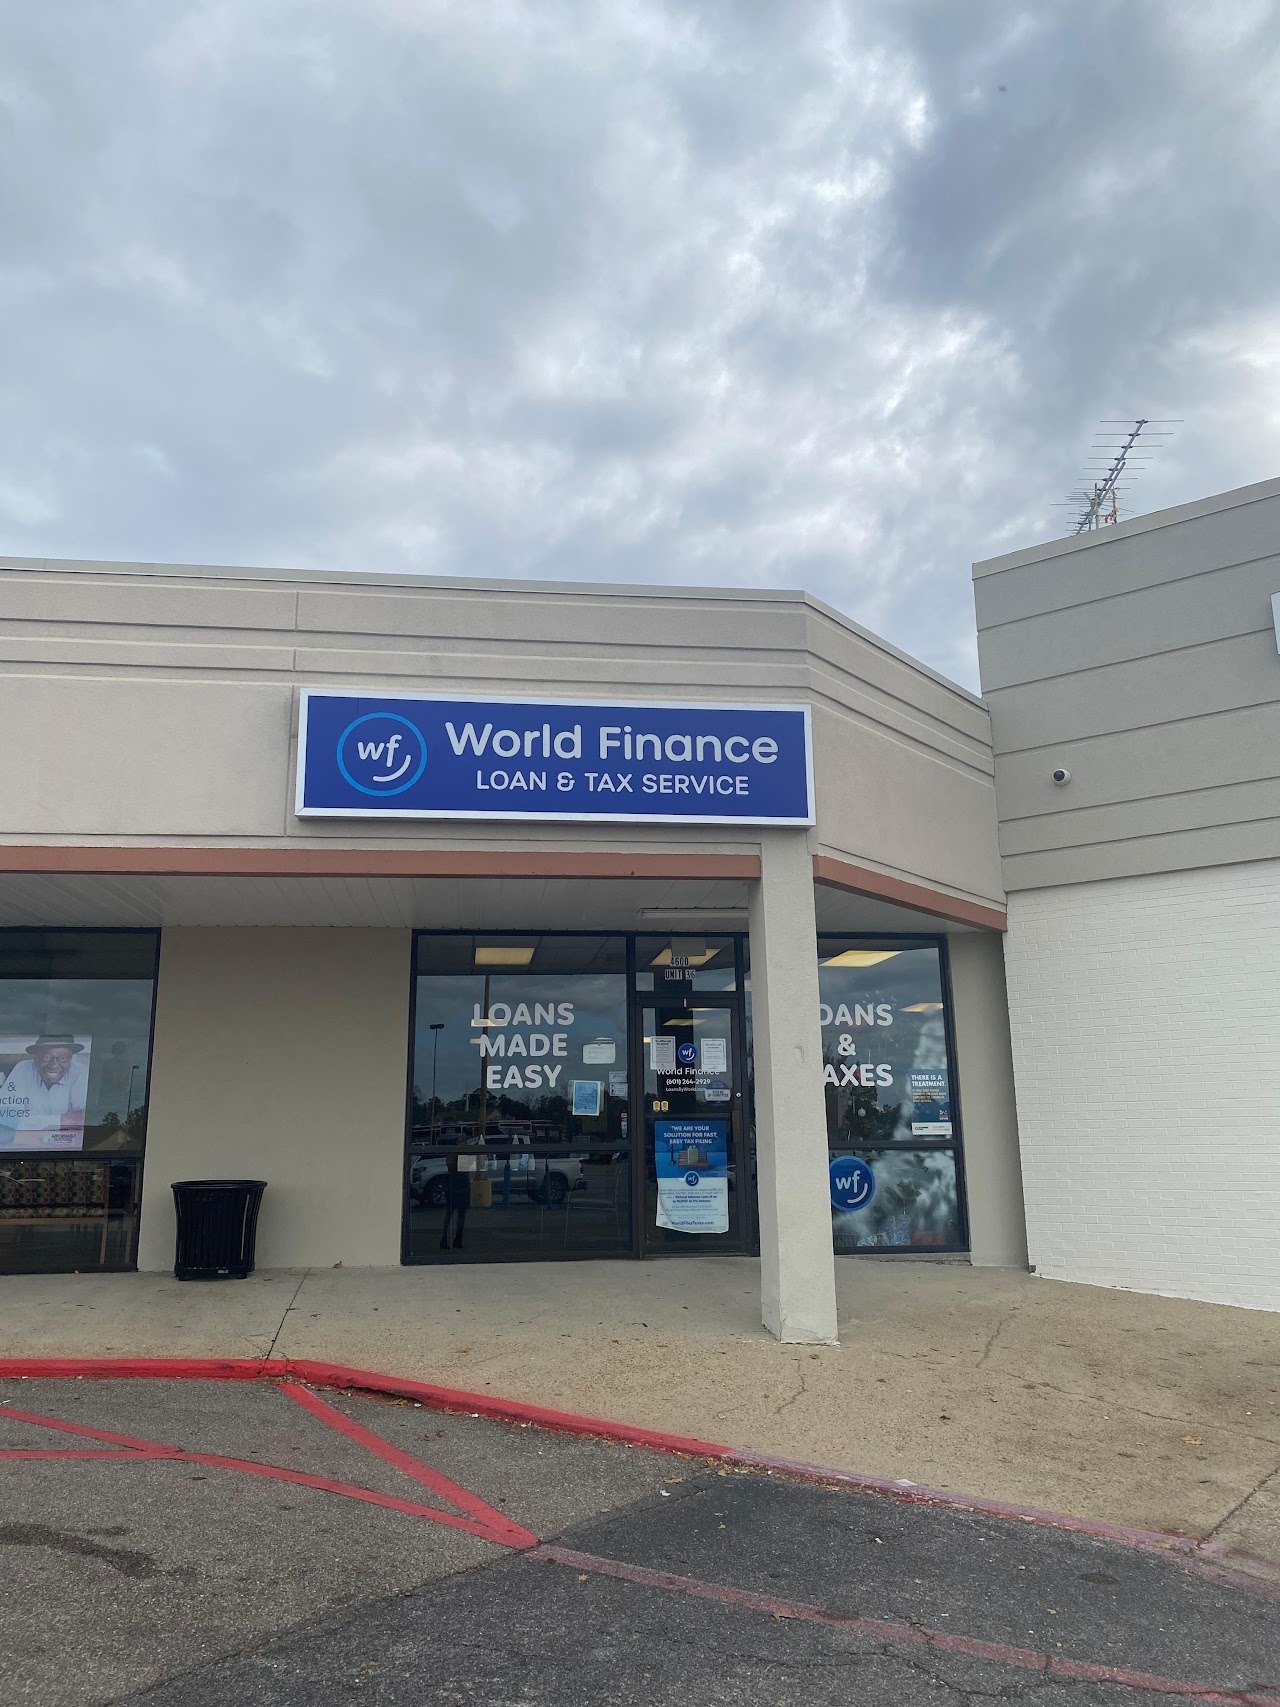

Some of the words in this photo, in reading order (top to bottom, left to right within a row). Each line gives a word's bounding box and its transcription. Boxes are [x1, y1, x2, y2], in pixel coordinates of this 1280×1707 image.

[357, 734, 403, 768] wf
[445, 721, 582, 760] World
[600, 725, 779, 764] Finance
[476, 769, 547, 791] LOAN
[557, 771, 575, 792] &
[584, 772, 634, 793] TAX
[641, 773, 749, 796] SERVICE
[664, 968, 683, 980] UNIT
[473, 1002, 575, 1026] LOANS
[819, 1003, 894, 1027] OANS
[479, 1033, 568, 1057] MADE
[838, 1033, 857, 1056] &
[487, 1064, 562, 1089] EASY
[657, 1067, 682, 1075] World
[823, 1063, 894, 1087] AXES
[7, 1081, 17, 1092] &
[0, 1095, 30, 1105] ction
